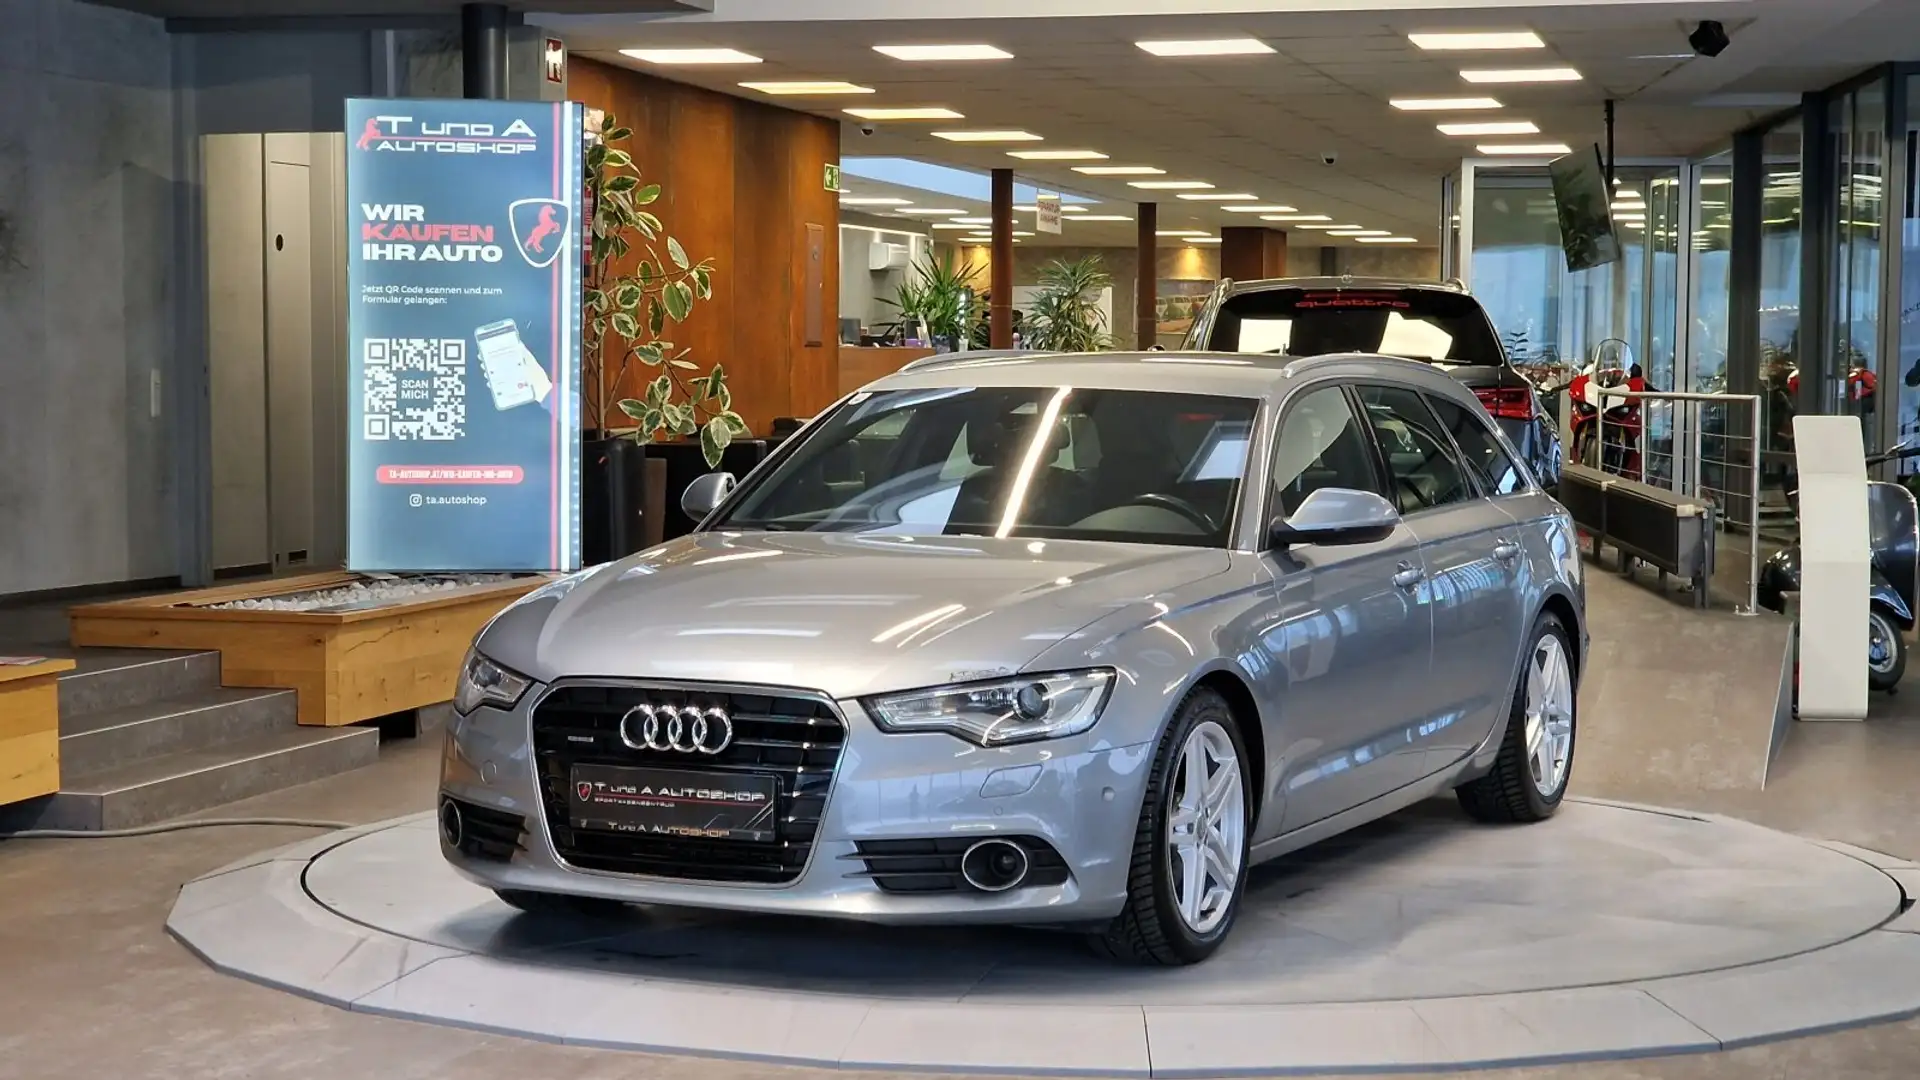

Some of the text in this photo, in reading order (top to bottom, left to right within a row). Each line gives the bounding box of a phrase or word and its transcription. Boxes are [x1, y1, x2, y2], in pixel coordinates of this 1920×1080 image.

[376, 116, 412, 134] T
[501, 118, 537, 137] A
[376, 140, 536, 154] AUTOSHOP
[361, 203, 424, 221] WIR
[361, 223, 494, 242] KAUFEN
[362, 243, 503, 262] IHR AUTO
[362, 285, 502, 295] Jetzt QR Code scannen und zum
[362, 295, 448, 306] Formular gelangen:
[401, 379, 429, 389] SCAN
[401, 390, 429, 400] MICH
[426, 494, 487, 506] ta.autoshop
[594, 783, 606, 791] T
[641, 786, 653, 795] A
[658, 787, 765, 802] AUTOSHOP
[652, 825, 730, 838] AUTOSHOP
